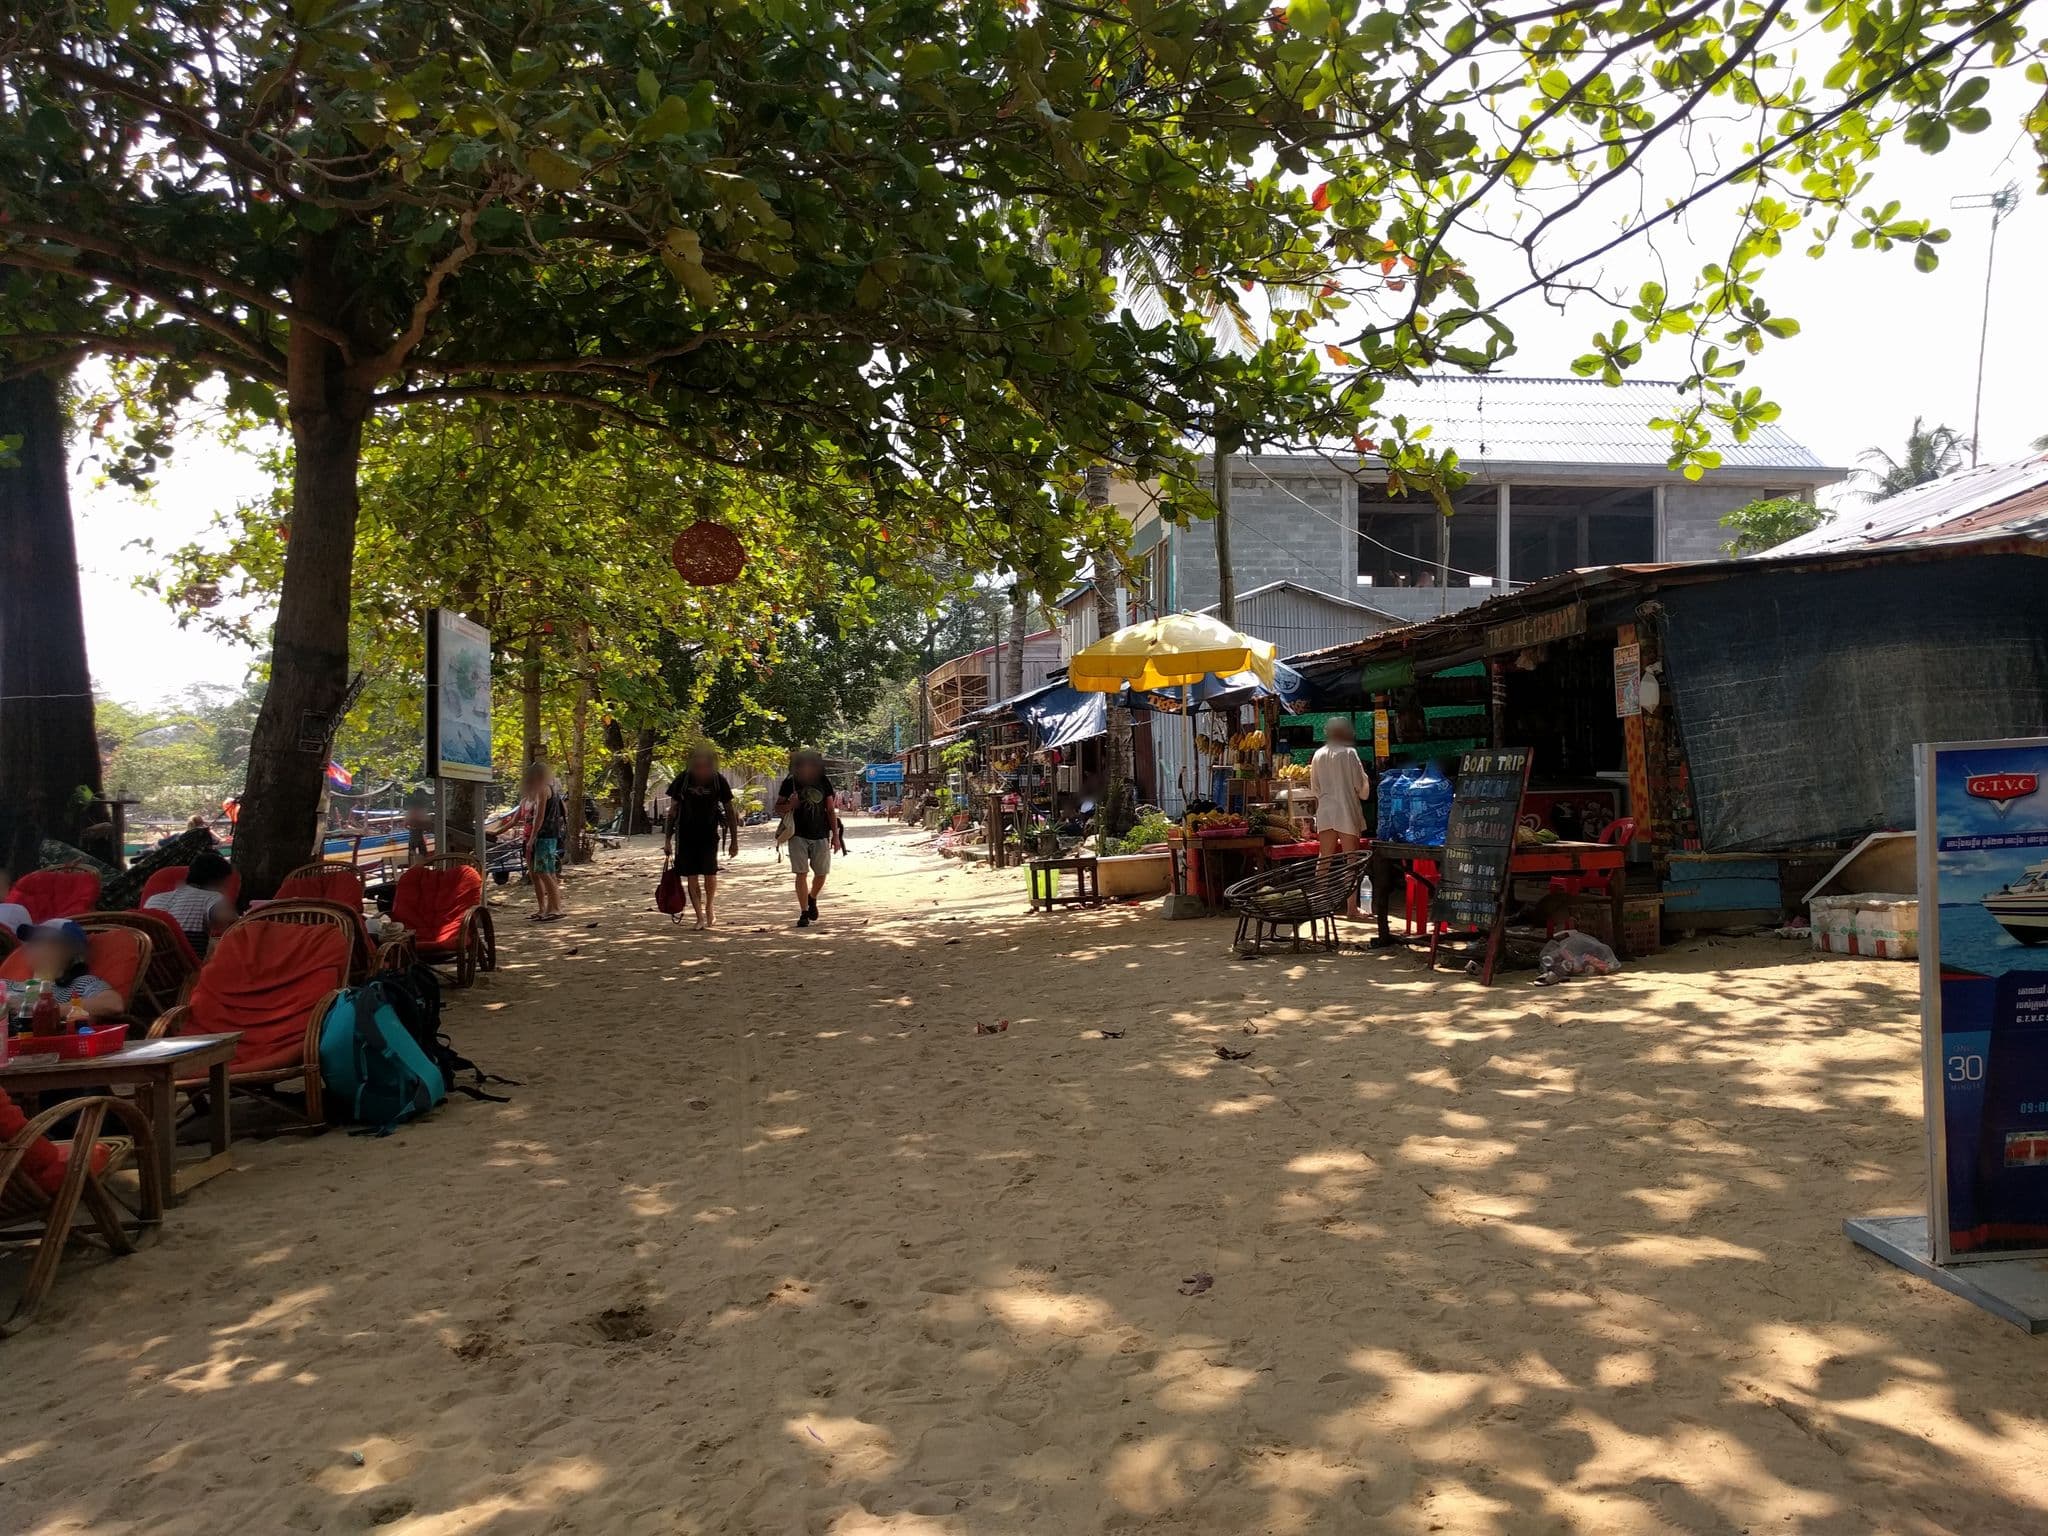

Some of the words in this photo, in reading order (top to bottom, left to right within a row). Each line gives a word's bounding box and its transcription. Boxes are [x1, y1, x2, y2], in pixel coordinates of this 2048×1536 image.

[1463, 754, 1492, 773] BOAT
[1498, 754, 1525, 772] TRIP
[1972, 778, 2031, 793] G.T.V.C
[1948, 1054, 1984, 1082] 30
